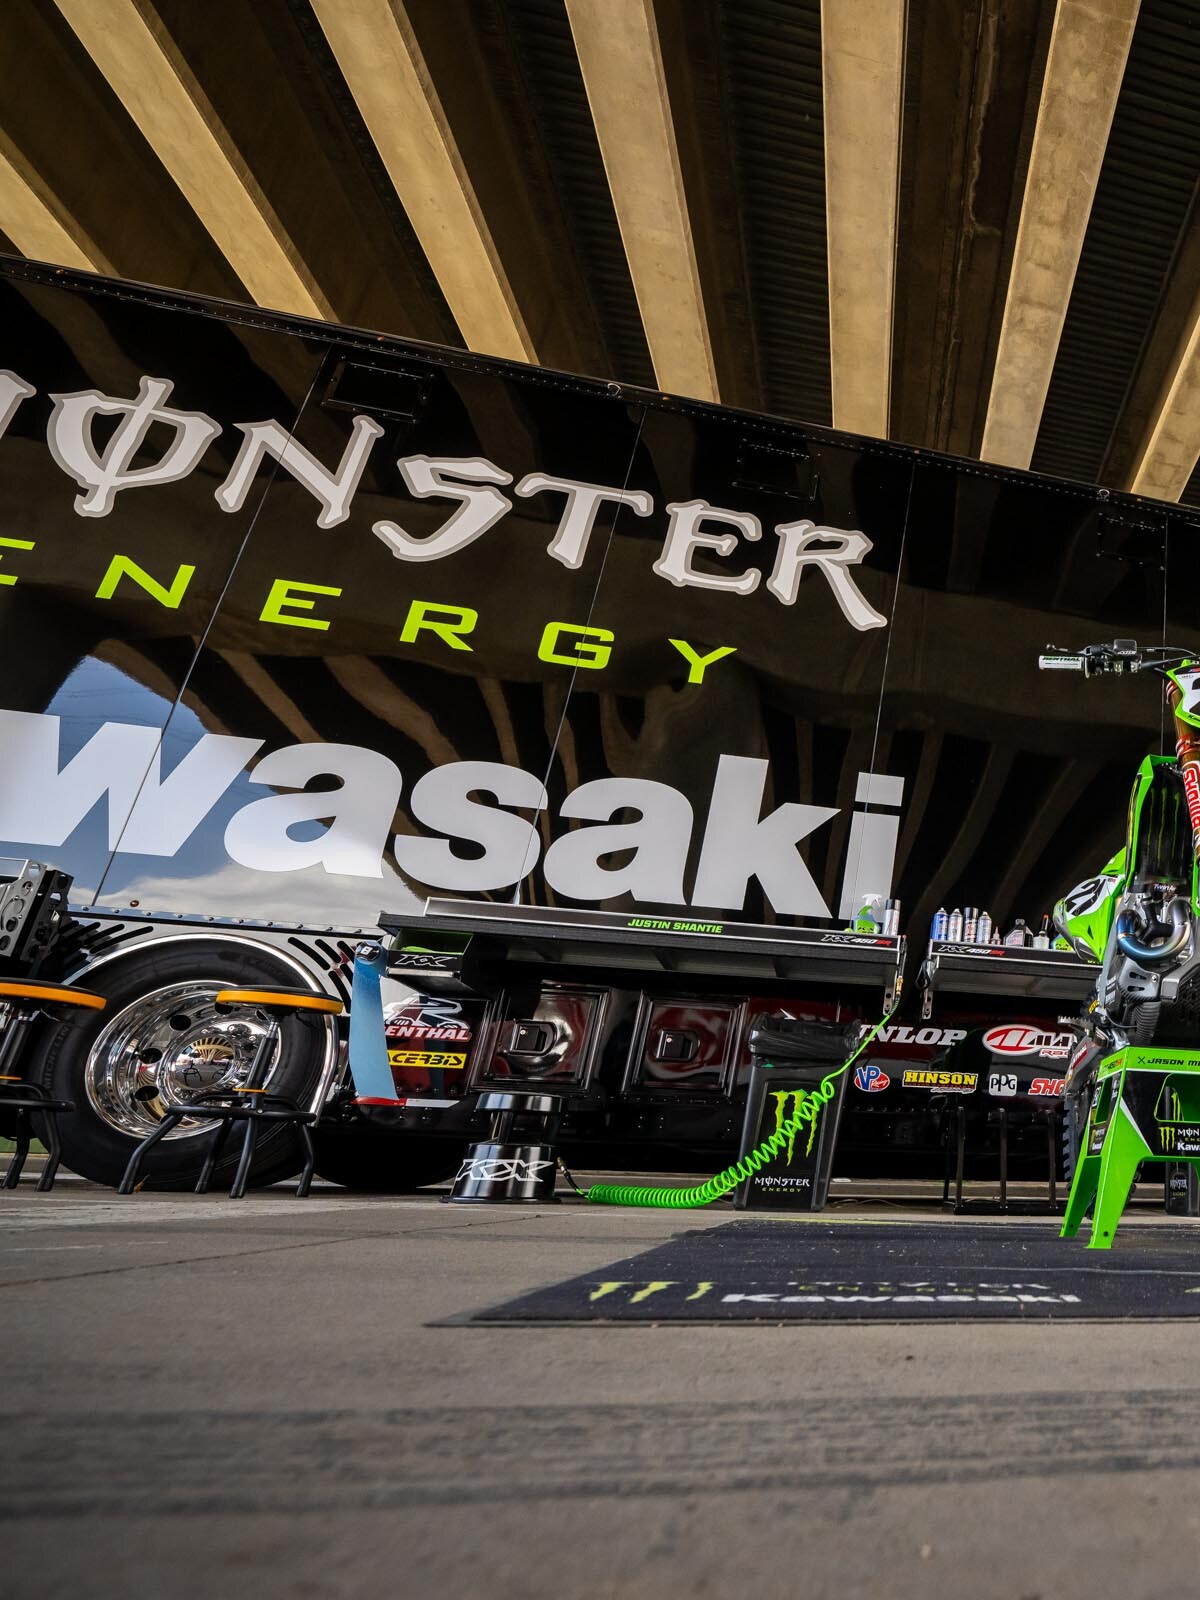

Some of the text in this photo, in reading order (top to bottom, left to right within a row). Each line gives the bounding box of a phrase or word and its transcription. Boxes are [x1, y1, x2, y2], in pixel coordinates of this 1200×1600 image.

[628, 918, 724, 934] JUSTIN SHANTIE
[385, 1026, 470, 1040] ENTHAL
[1147, 1058, 1184, 1066] JASON
[856, 1066, 881, 1091] VP
[904, 1071, 976, 1086] HINSON
[990, 1074, 1017, 1092] PPG
[754, 1176, 811, 1188] MONSTER
